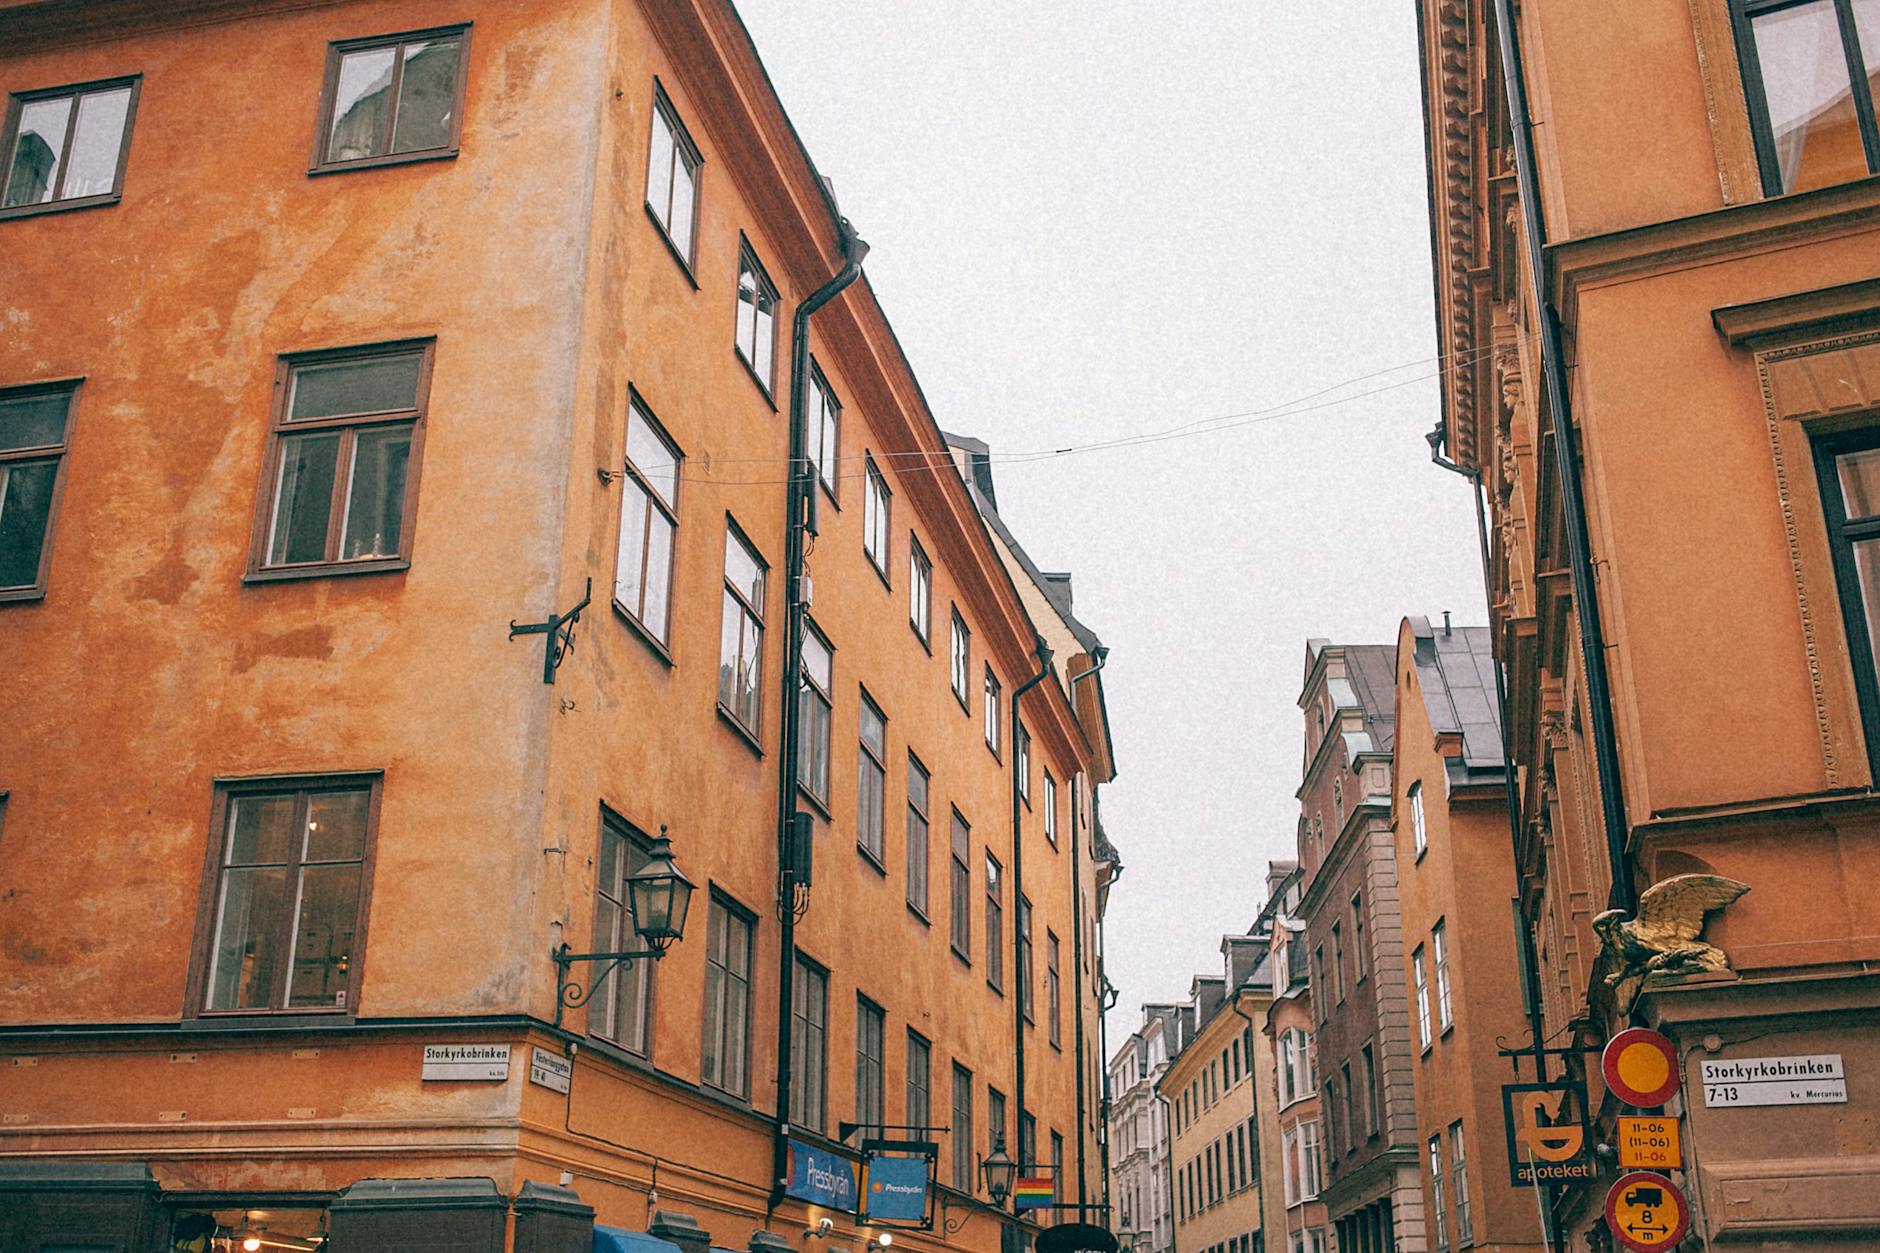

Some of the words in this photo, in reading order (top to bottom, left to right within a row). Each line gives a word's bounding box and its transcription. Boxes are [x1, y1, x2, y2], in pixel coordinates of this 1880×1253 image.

[426, 1047, 507, 1061] Storkyrkobrinken
[1705, 1060, 1834, 1081] Storkyrkobrinken
[1708, 1087, 1738, 1102] 7-13
[1790, 1091, 1800, 1099] kv
[1806, 1090, 1843, 1098] Mercurius
[1632, 1123, 1665, 1133] 11-06
[1629, 1137, 1670, 1148] (11-06)
[1635, 1151, 1666, 1162] 11-06
[807, 1157, 849, 1198] Pressbyrån
[1518, 1164, 1589, 1182] apoteket
[885, 1183, 922, 1194] Pressbyrån
[1641, 1210, 1653, 1224] 8
[1642, 1231, 1654, 1241] m
